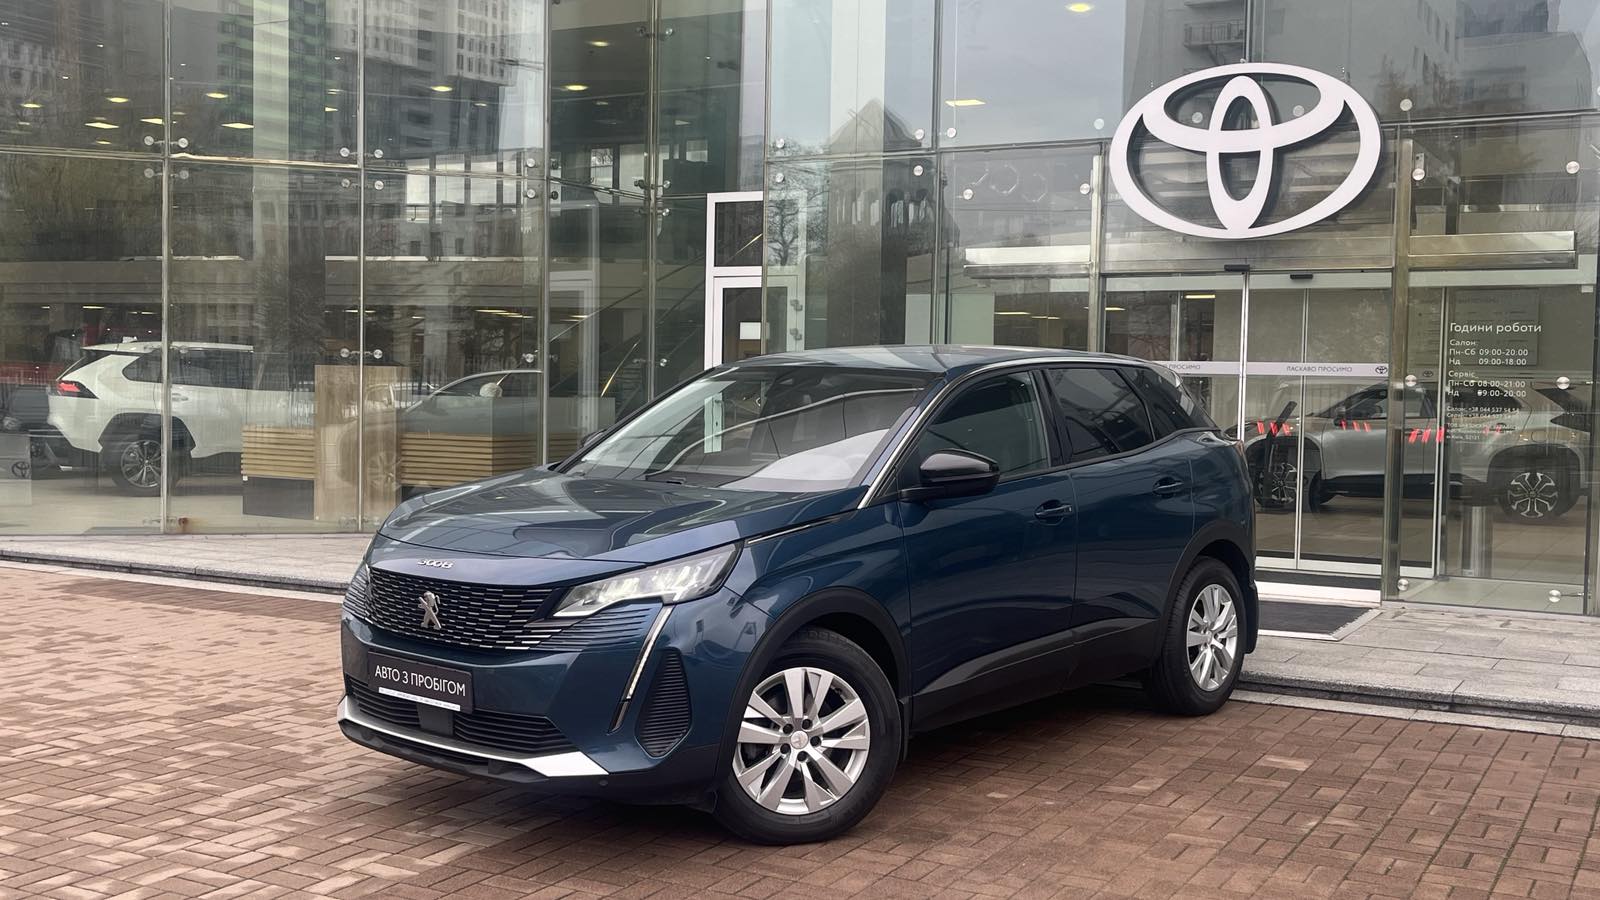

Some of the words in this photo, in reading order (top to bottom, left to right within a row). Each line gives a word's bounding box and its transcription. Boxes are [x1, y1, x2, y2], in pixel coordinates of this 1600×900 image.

[1450, 323, 1493, 333] Години
[1496, 322, 1542, 334] роботи
[1449, 348, 1476, 356] Пн-Сб
[1286, 365, 1317, 373] ЛАСКАВО
[375, 665, 400, 682] АВТО
[411, 673, 466, 697] ПРОБІГОМ
